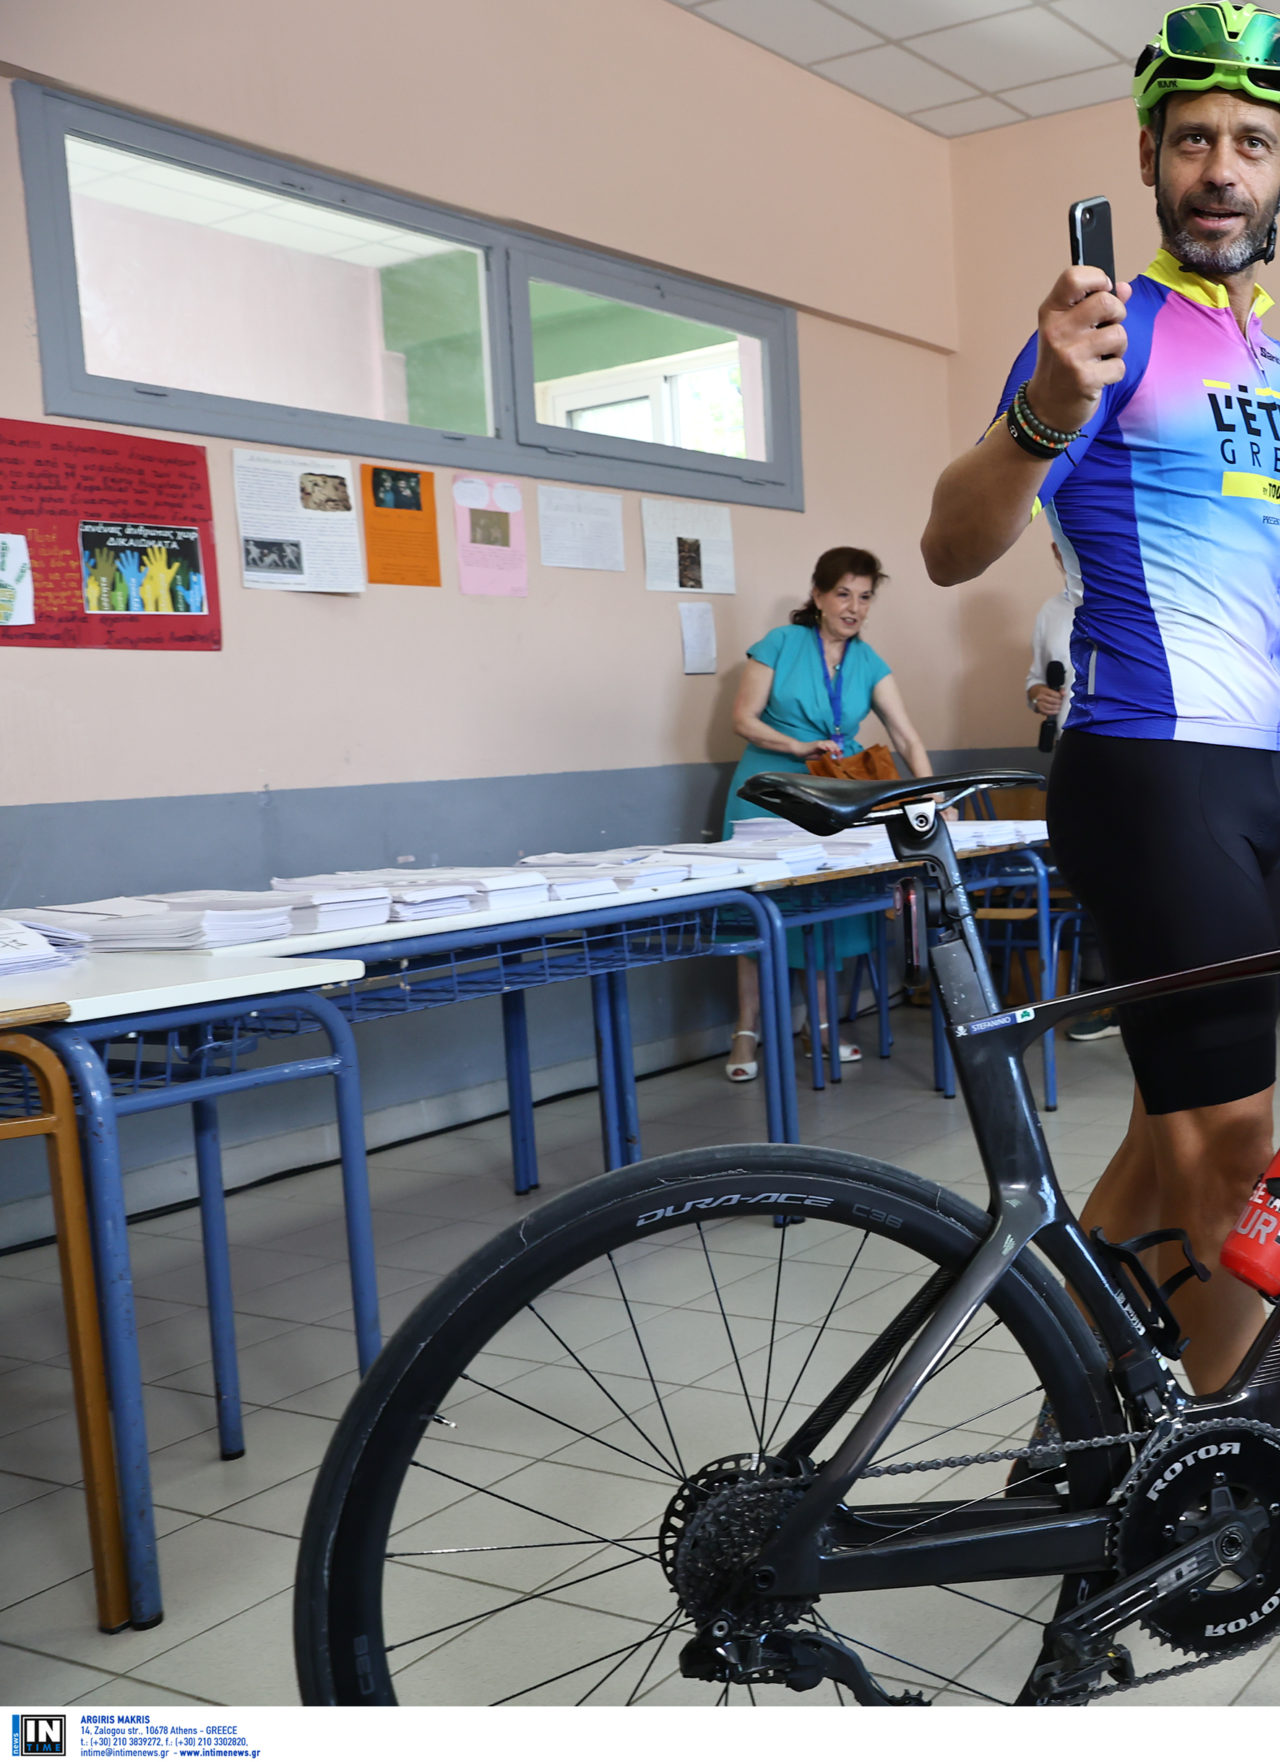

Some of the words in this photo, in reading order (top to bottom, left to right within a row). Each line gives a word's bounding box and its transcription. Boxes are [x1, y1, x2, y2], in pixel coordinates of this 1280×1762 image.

[635, 1191, 836, 1228] DURA-ACE
[851, 1202, 904, 1230] C36
[1146, 1441, 1242, 1502] ROTOR
